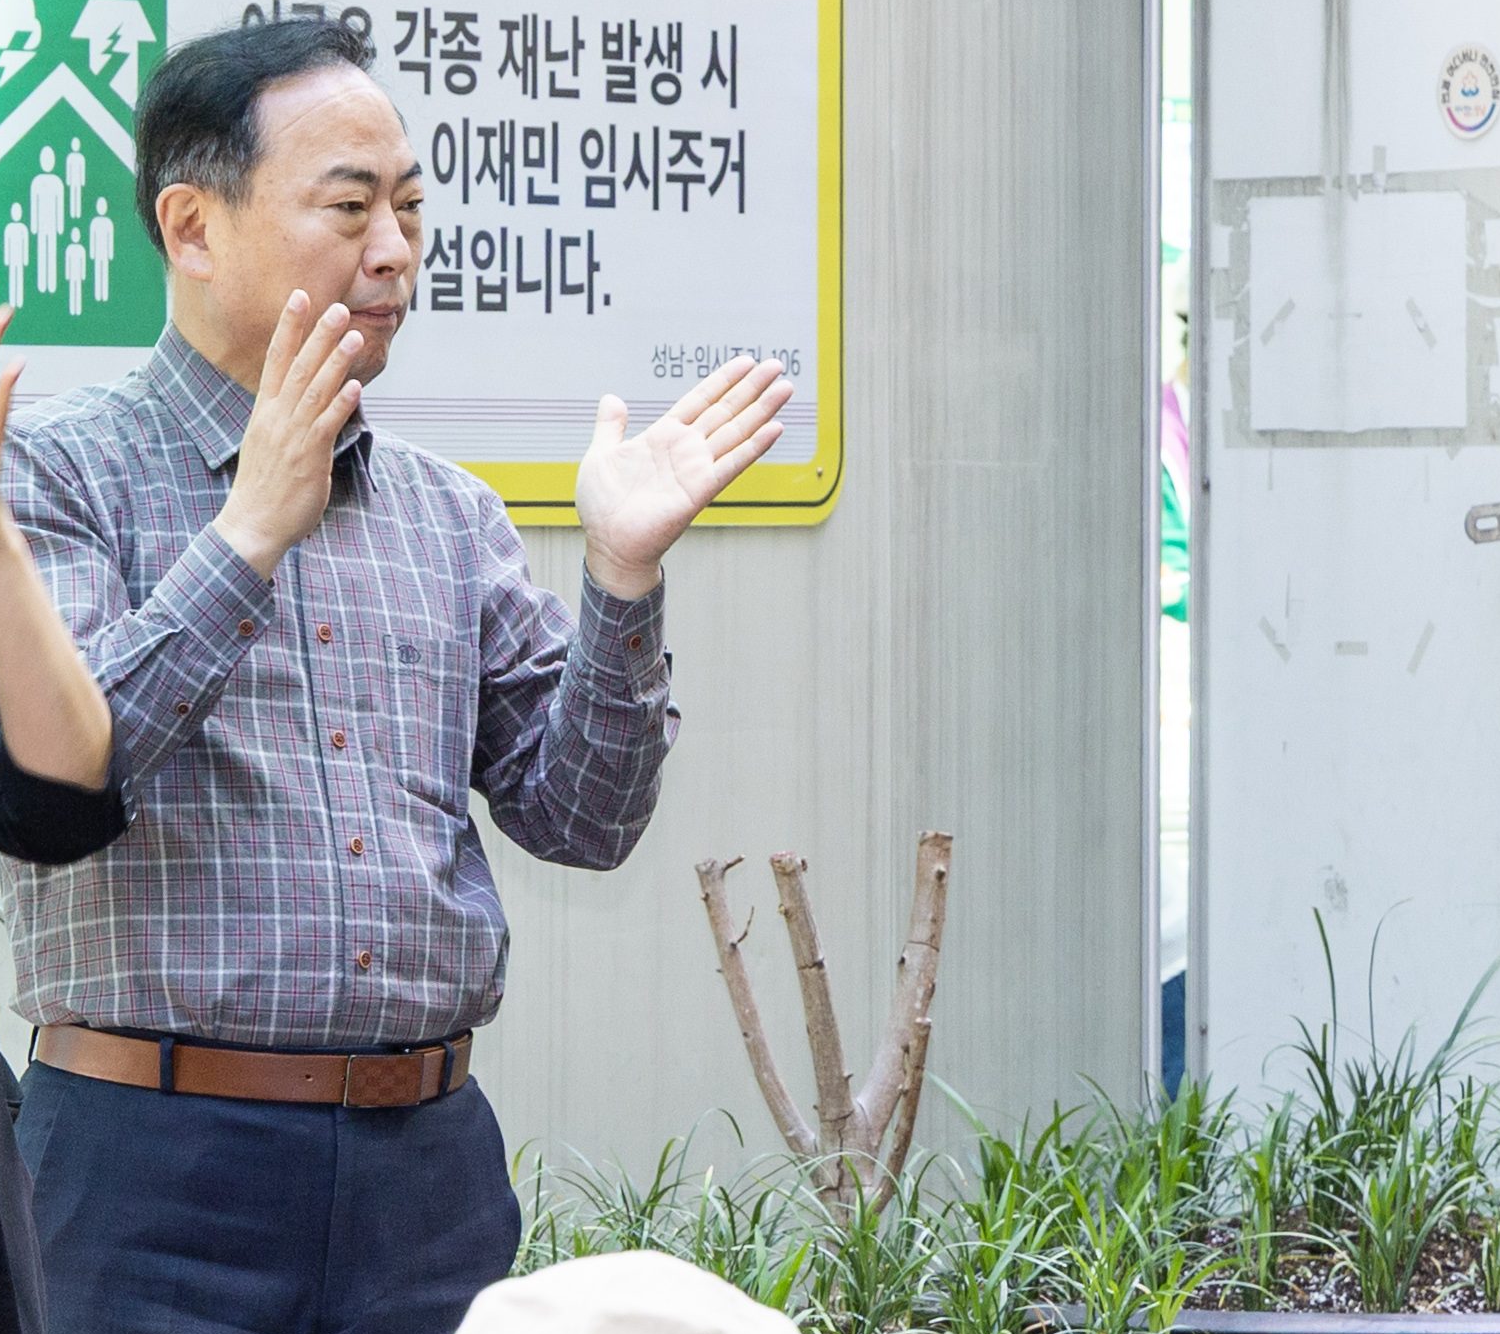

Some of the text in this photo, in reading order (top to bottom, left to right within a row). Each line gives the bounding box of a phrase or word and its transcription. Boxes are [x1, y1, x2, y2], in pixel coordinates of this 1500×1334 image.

[394, 6, 482, 96] 각종
[499, 13, 585, 100] 재난
[601, 19, 683, 105] 발생
[701, 24, 737, 109] 시
[431, 117, 746, 214] 이재민 임시주거
[409, 225, 611, 316] 설입니다.
